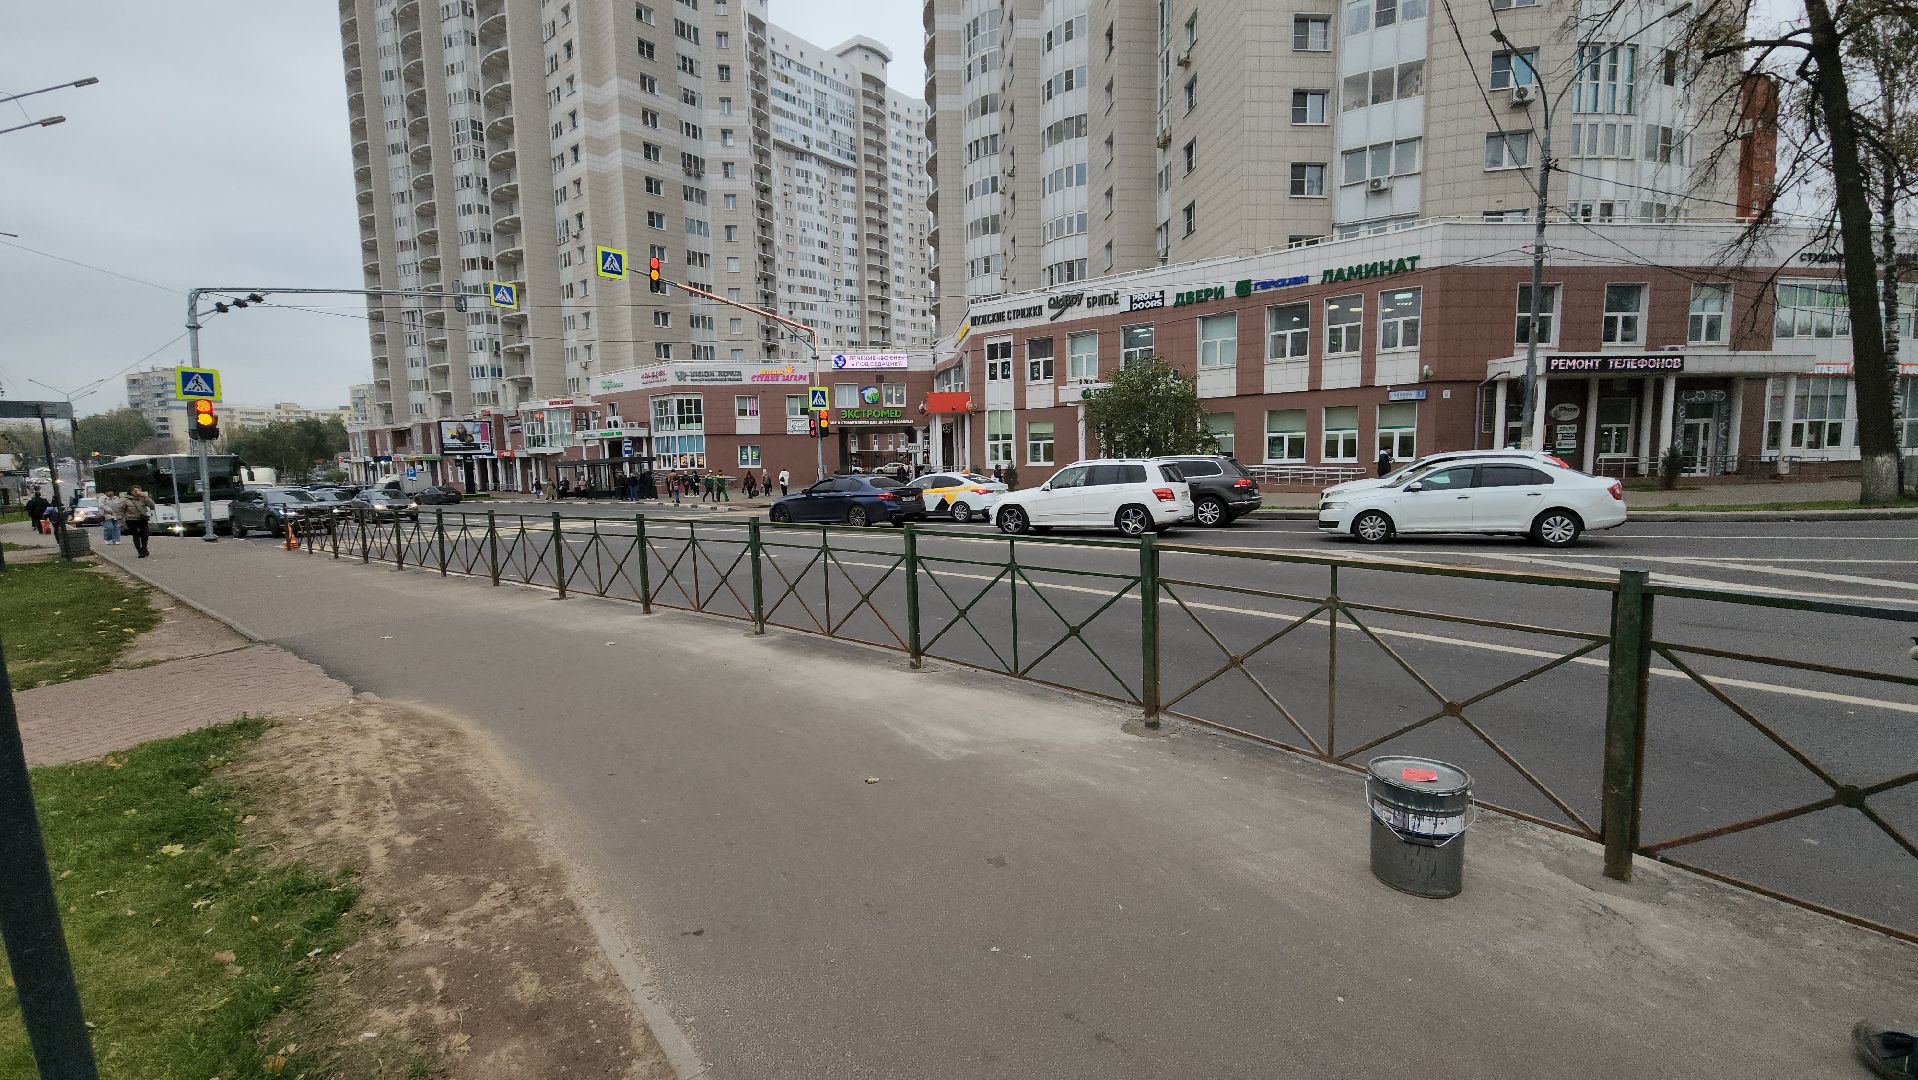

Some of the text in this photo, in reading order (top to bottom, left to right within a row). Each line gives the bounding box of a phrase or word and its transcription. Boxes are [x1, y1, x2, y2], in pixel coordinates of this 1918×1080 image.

[1321, 255, 1420, 285] ЛАМИНАТ
[1086, 290, 1119, 308] БРИТЬЁ
[1132, 299, 1163, 310] DOORS
[1173, 285, 1225, 308] ДВЕРИ
[970, 305, 1043, 327] МУЖСКИЕ СТРИЖКИ
[1550, 358, 1681, 370] РЕМОНТ ТЕЛЕФОНОВ
